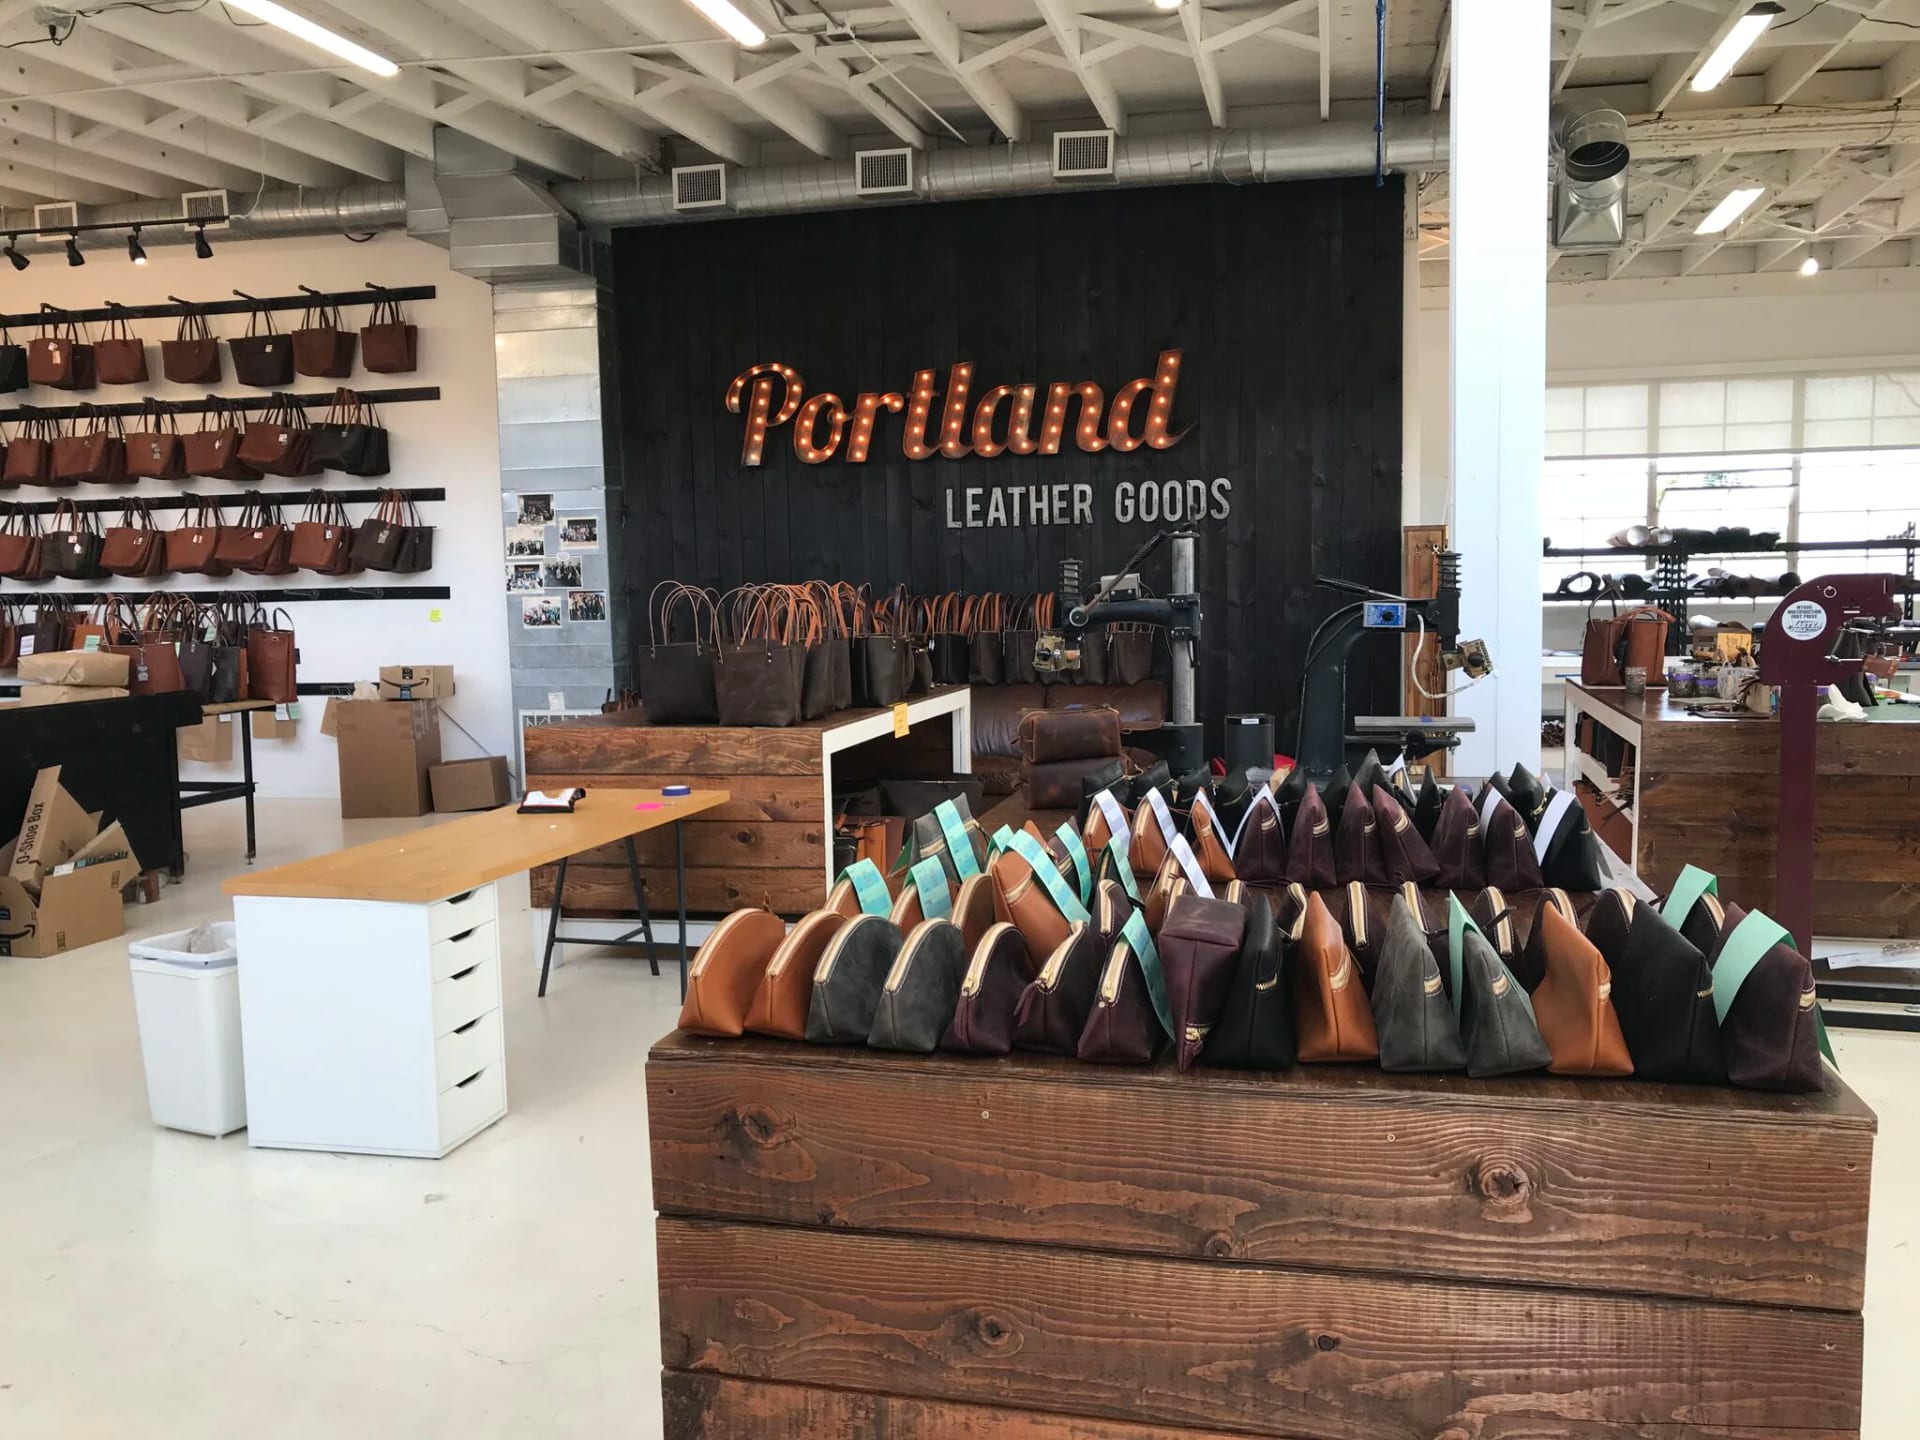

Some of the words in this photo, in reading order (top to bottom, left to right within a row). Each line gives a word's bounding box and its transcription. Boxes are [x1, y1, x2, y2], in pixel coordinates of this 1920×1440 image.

[726, 348, 1196, 467] Portland
[946, 484, 1093, 529] LEATHER
[1114, 478, 1232, 523] GOODS
[27, 801, 45, 825] Box
